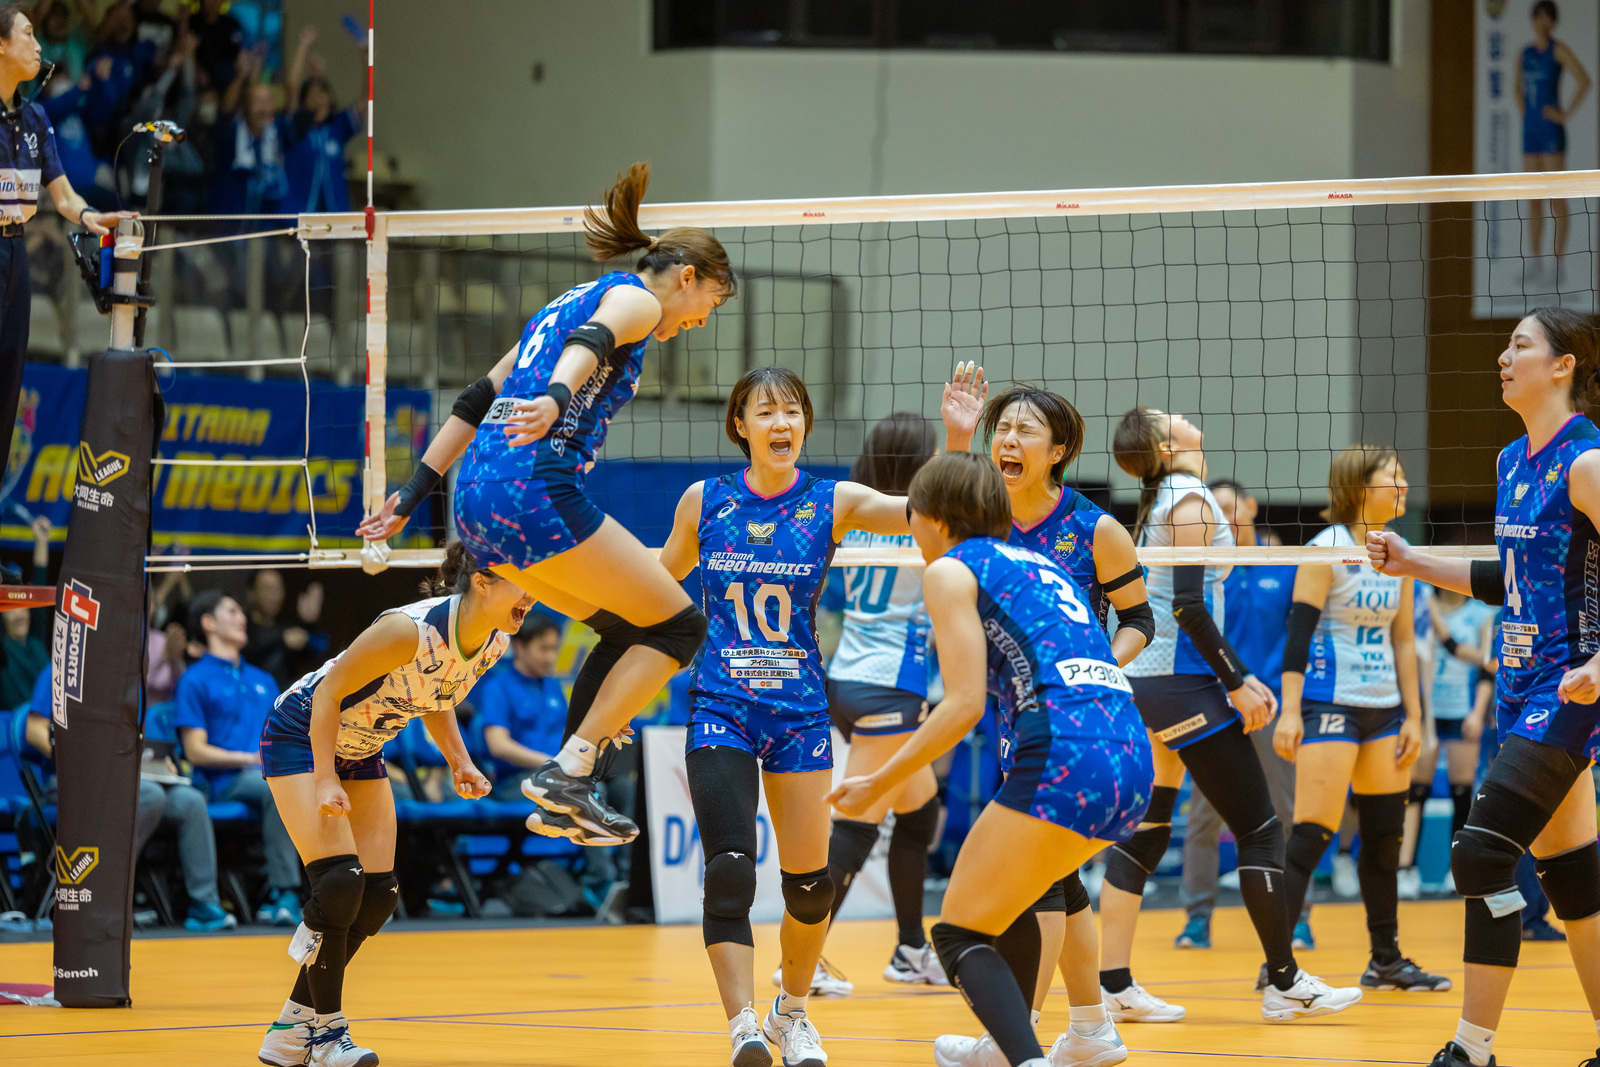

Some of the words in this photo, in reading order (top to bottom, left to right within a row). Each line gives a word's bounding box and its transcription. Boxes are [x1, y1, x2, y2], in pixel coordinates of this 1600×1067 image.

[517, 311, 560, 369] 6
[163, 402, 272, 446] ITAMA
[94, 458, 124, 483] LEAGUE
[707, 558, 747, 572] AGEO
[746, 561, 814, 576] MEDICS
[710, 551, 755, 561] SAITAMA
[843, 566, 899, 614] 20
[1038, 568, 1091, 625] 3
[1504, 548, 1523, 616] 4
[70, 594, 90, 621] J
[724, 582, 792, 643] 10
[54, 626, 65, 716] オンデマンド
[67, 621, 82, 688] SPORTS
[743, 669, 769, 677] 株式会社
[1318, 713, 1346, 735] 12
[69, 853, 94, 881] LEAGUE
[57, 966, 99, 979] Senoh
